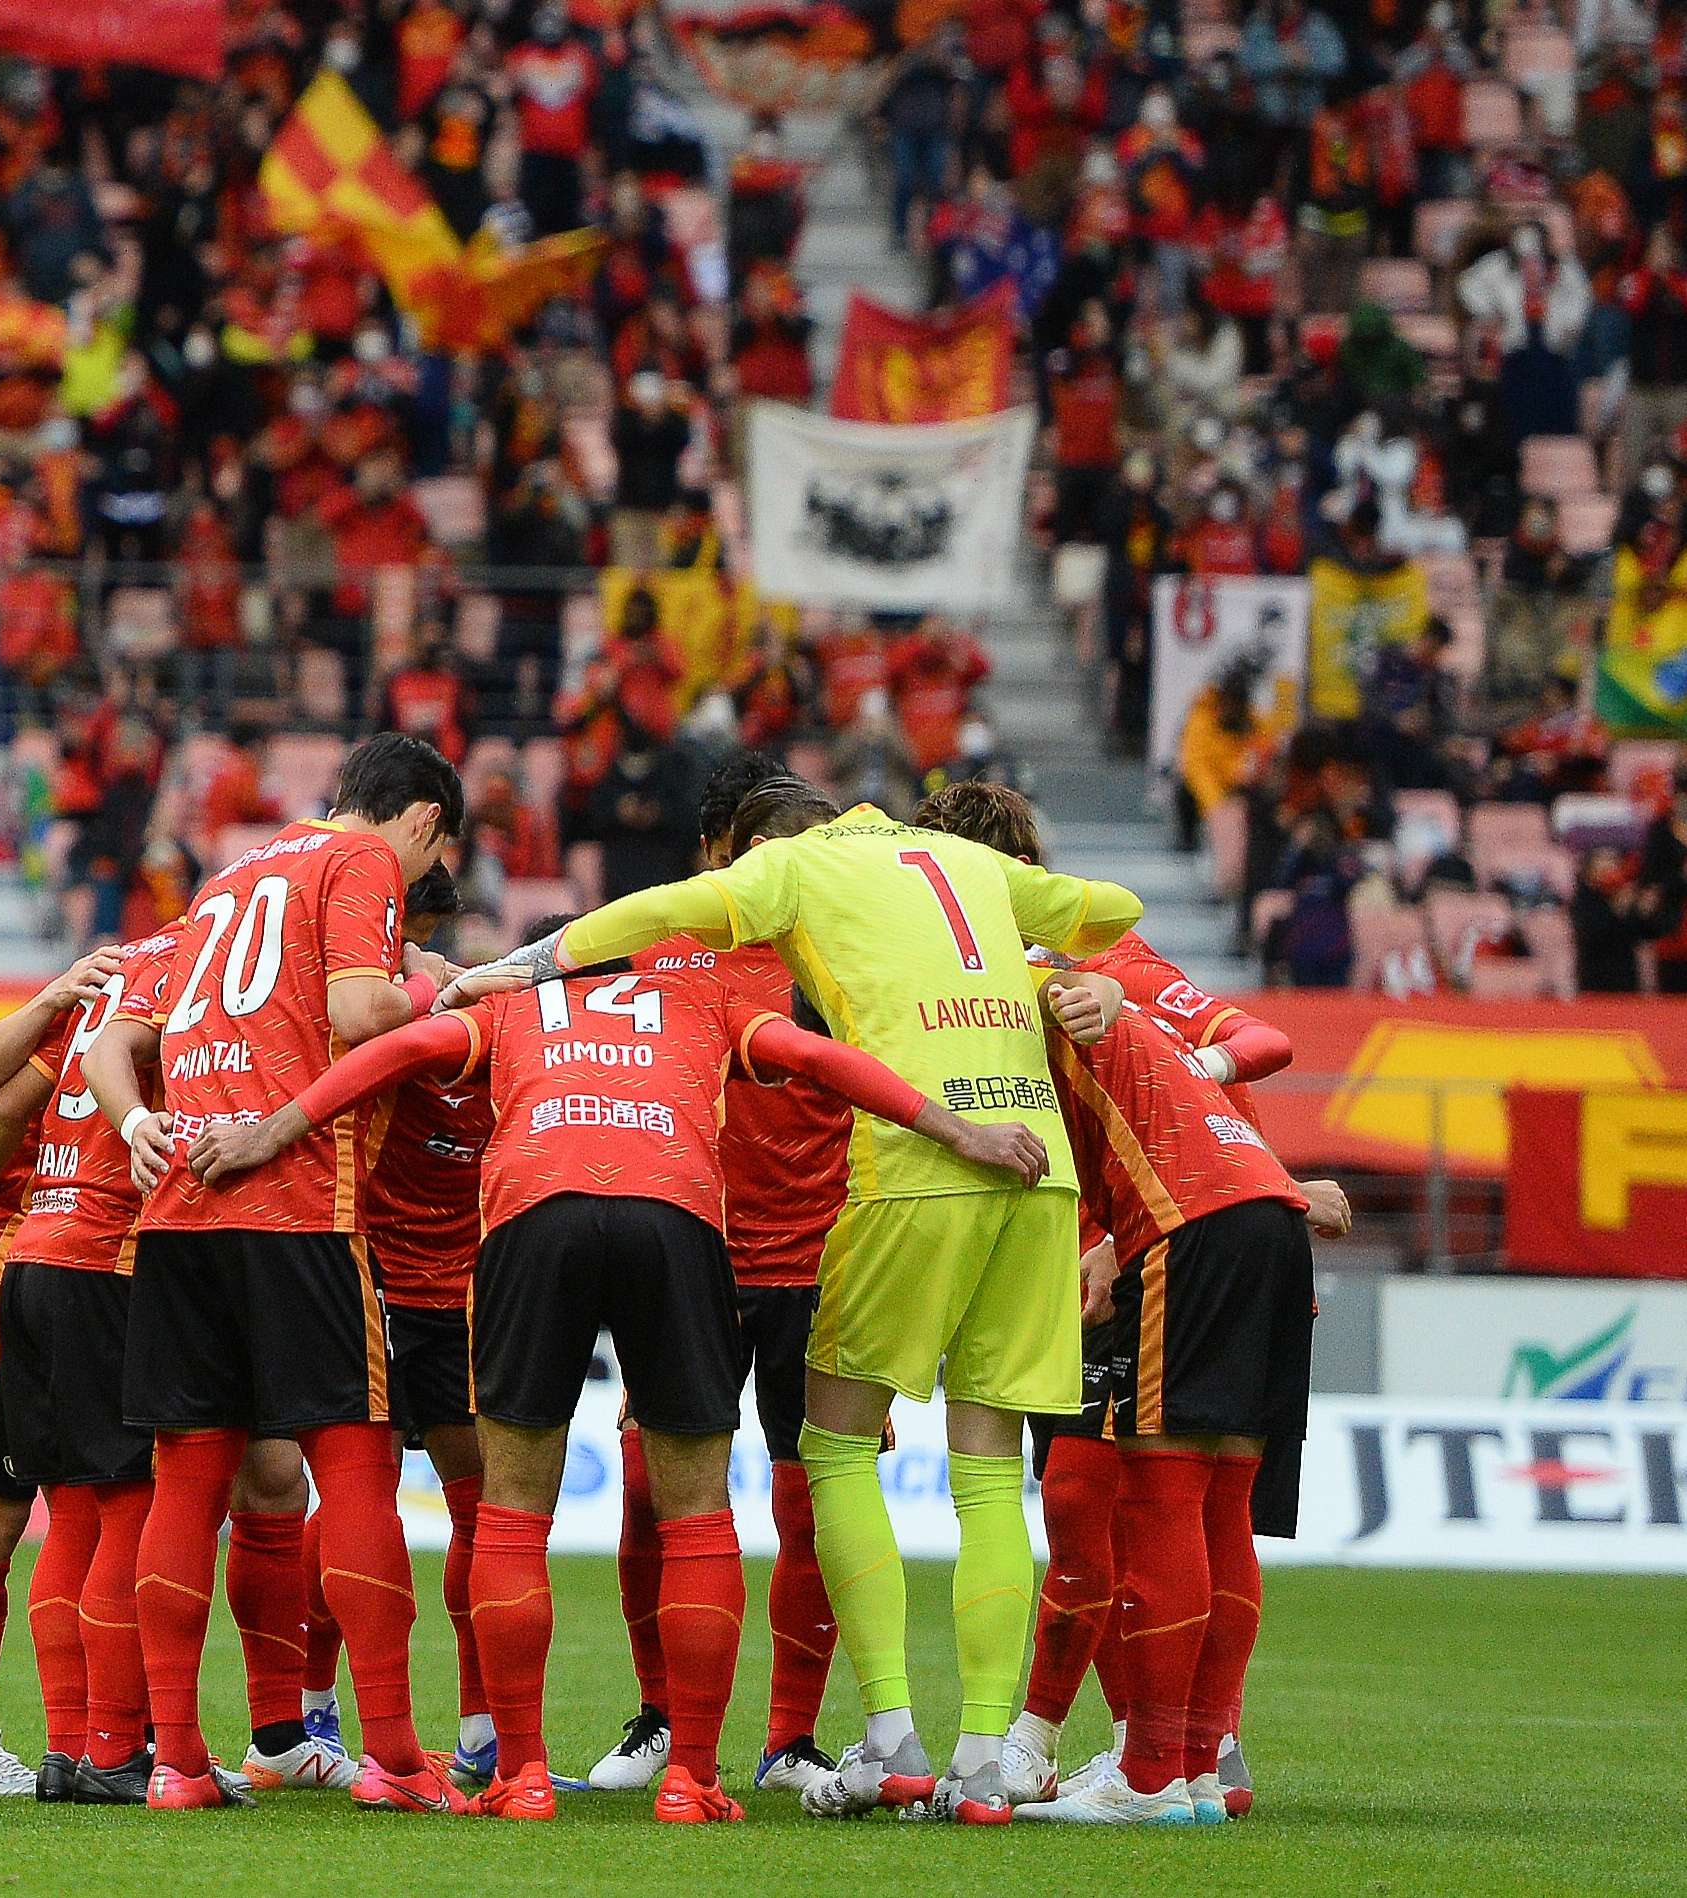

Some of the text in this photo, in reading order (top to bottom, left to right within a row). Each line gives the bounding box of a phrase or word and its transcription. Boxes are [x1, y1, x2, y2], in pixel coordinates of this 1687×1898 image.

[896, 846, 990, 975] 1
[162, 872, 291, 1037] 20
[654, 951, 717, 971] au 5G
[535, 973, 664, 1036] 14
[917, 995, 1039, 1036] LANGERAK
[169, 1038, 256, 1081] MINTAE
[542, 1040, 655, 1070] KIMOTO
[527, 1094, 676, 1137] 豊田通商
